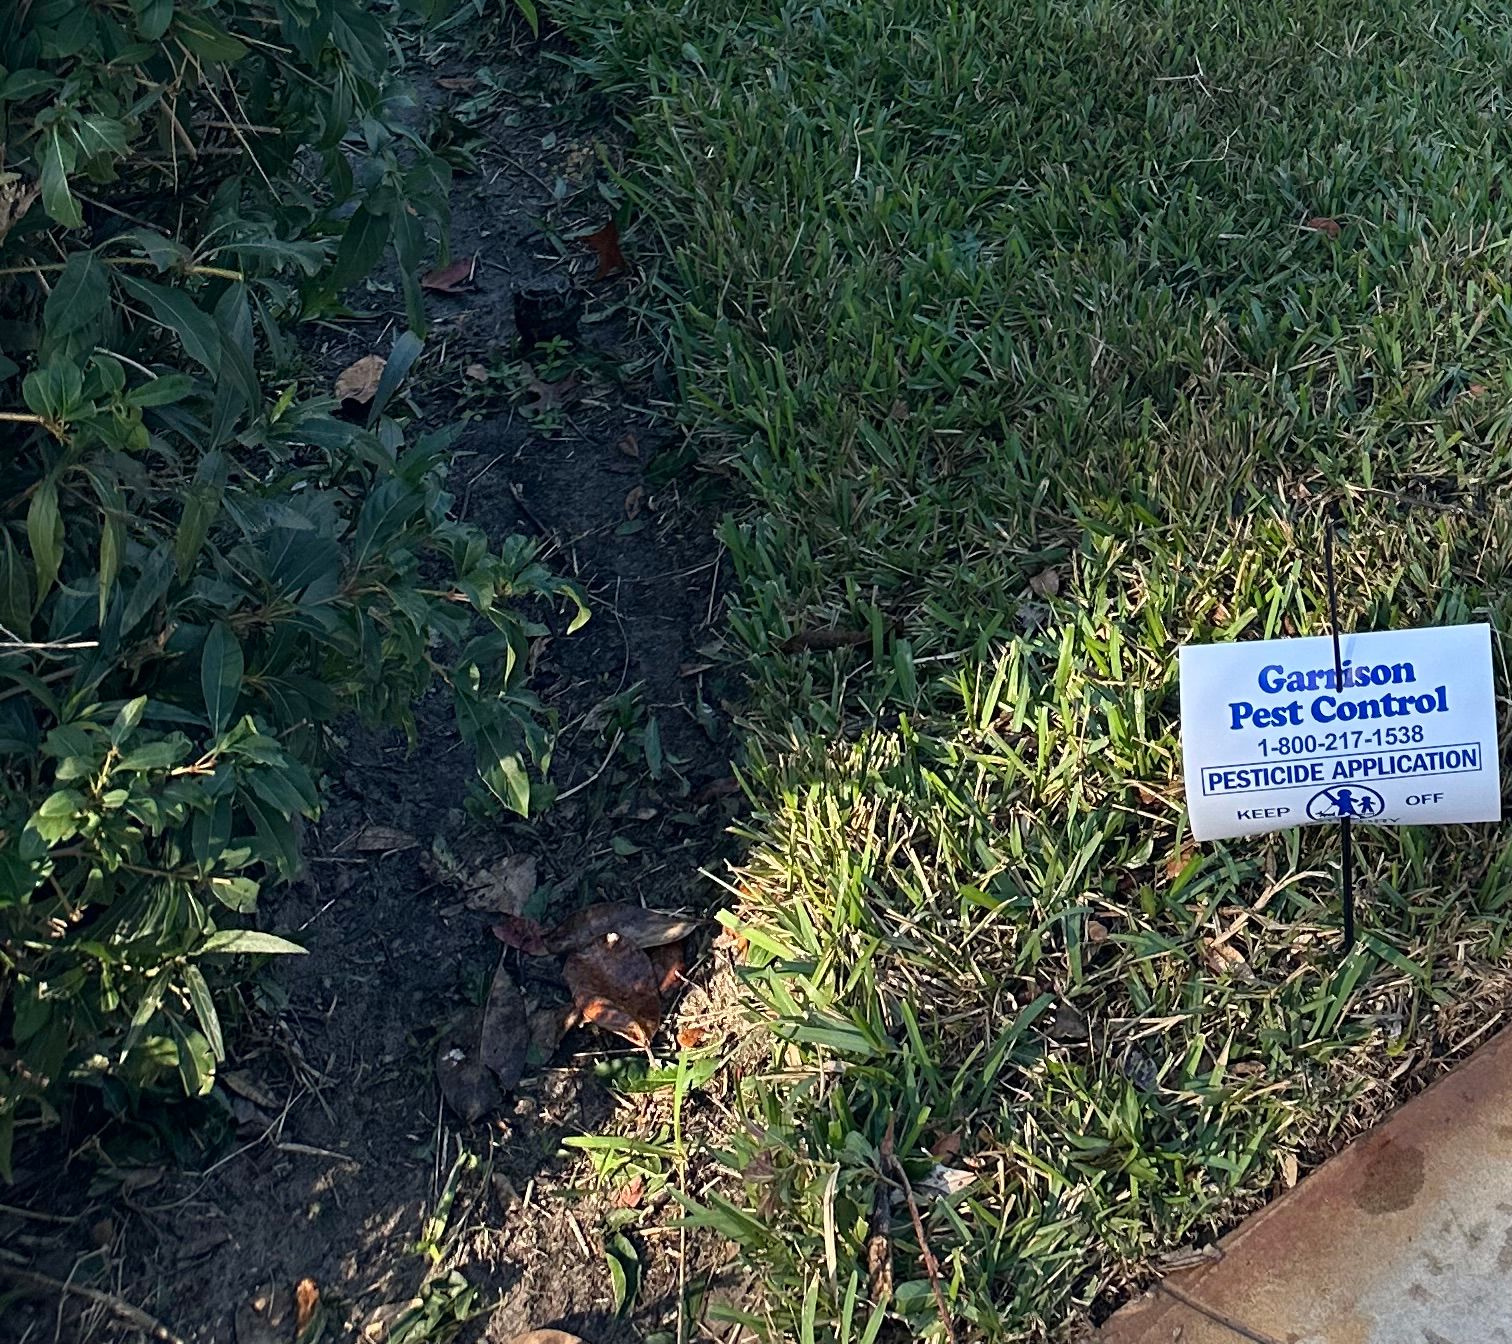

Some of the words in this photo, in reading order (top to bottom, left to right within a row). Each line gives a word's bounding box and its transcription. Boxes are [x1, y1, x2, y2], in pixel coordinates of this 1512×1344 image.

[1258, 659, 1416, 694] Garrison
[1229, 701, 1304, 730] Pest
[1311, 686, 1449, 723] Control
[1258, 724, 1424, 757] 1-800-217-1538
[1208, 762, 1325, 791] PESTICIDE
[1332, 748, 1477, 780] APPLICATION
[1237, 806, 1291, 821] KEEP
[1405, 792, 1444, 806] OFF
